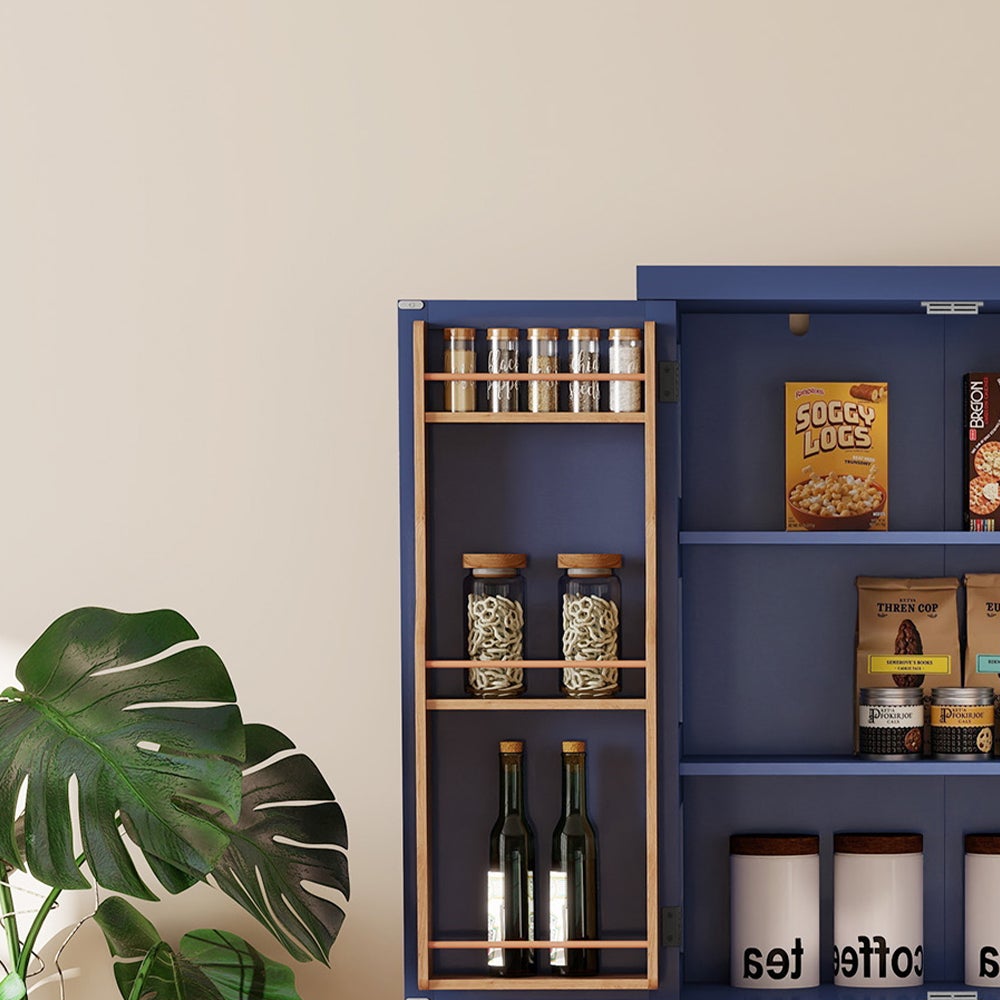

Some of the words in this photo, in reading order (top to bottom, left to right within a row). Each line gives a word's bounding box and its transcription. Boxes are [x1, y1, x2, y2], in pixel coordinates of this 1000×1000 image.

[795, 400, 876, 434] SOGGY
[804, 425, 872, 459] LOGS
[877, 602, 915, 613] THREN
[918, 603, 939, 613] COP
